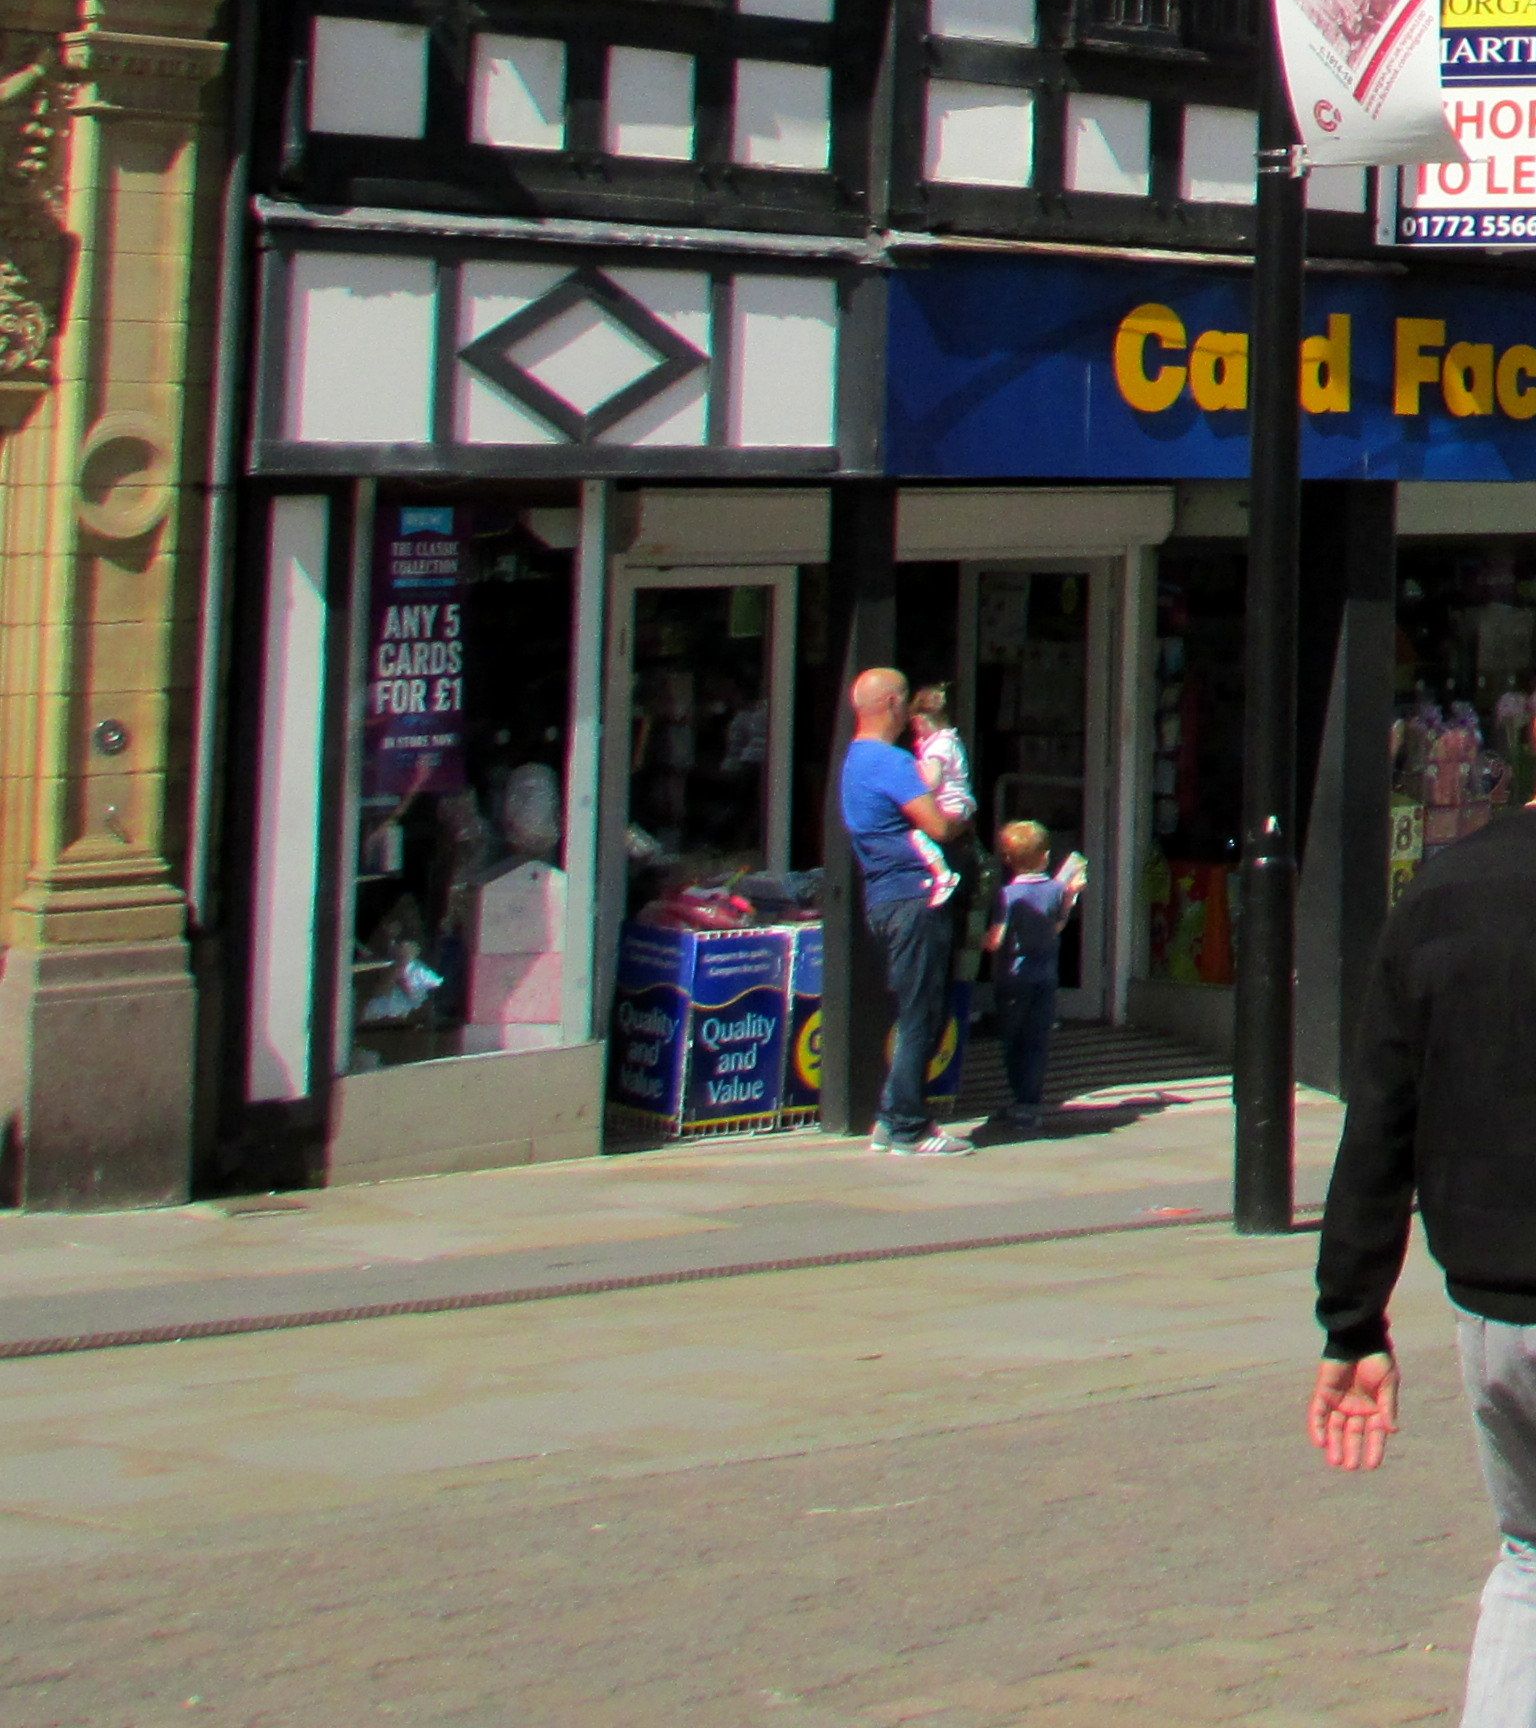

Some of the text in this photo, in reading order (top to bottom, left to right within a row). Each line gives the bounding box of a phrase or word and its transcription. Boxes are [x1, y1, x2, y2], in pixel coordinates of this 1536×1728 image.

[1402, 216, 1475, 237] 01772
[1115, 303, 1351, 413] Cad
[384, 603, 461, 640] ANY 5
[378, 640, 463, 677] CARDS
[375, 677, 463, 714] FOR £1
[701, 1012, 779, 1051] Quality
[717, 1048, 758, 1072] and
[706, 1076, 765, 1106] Value
